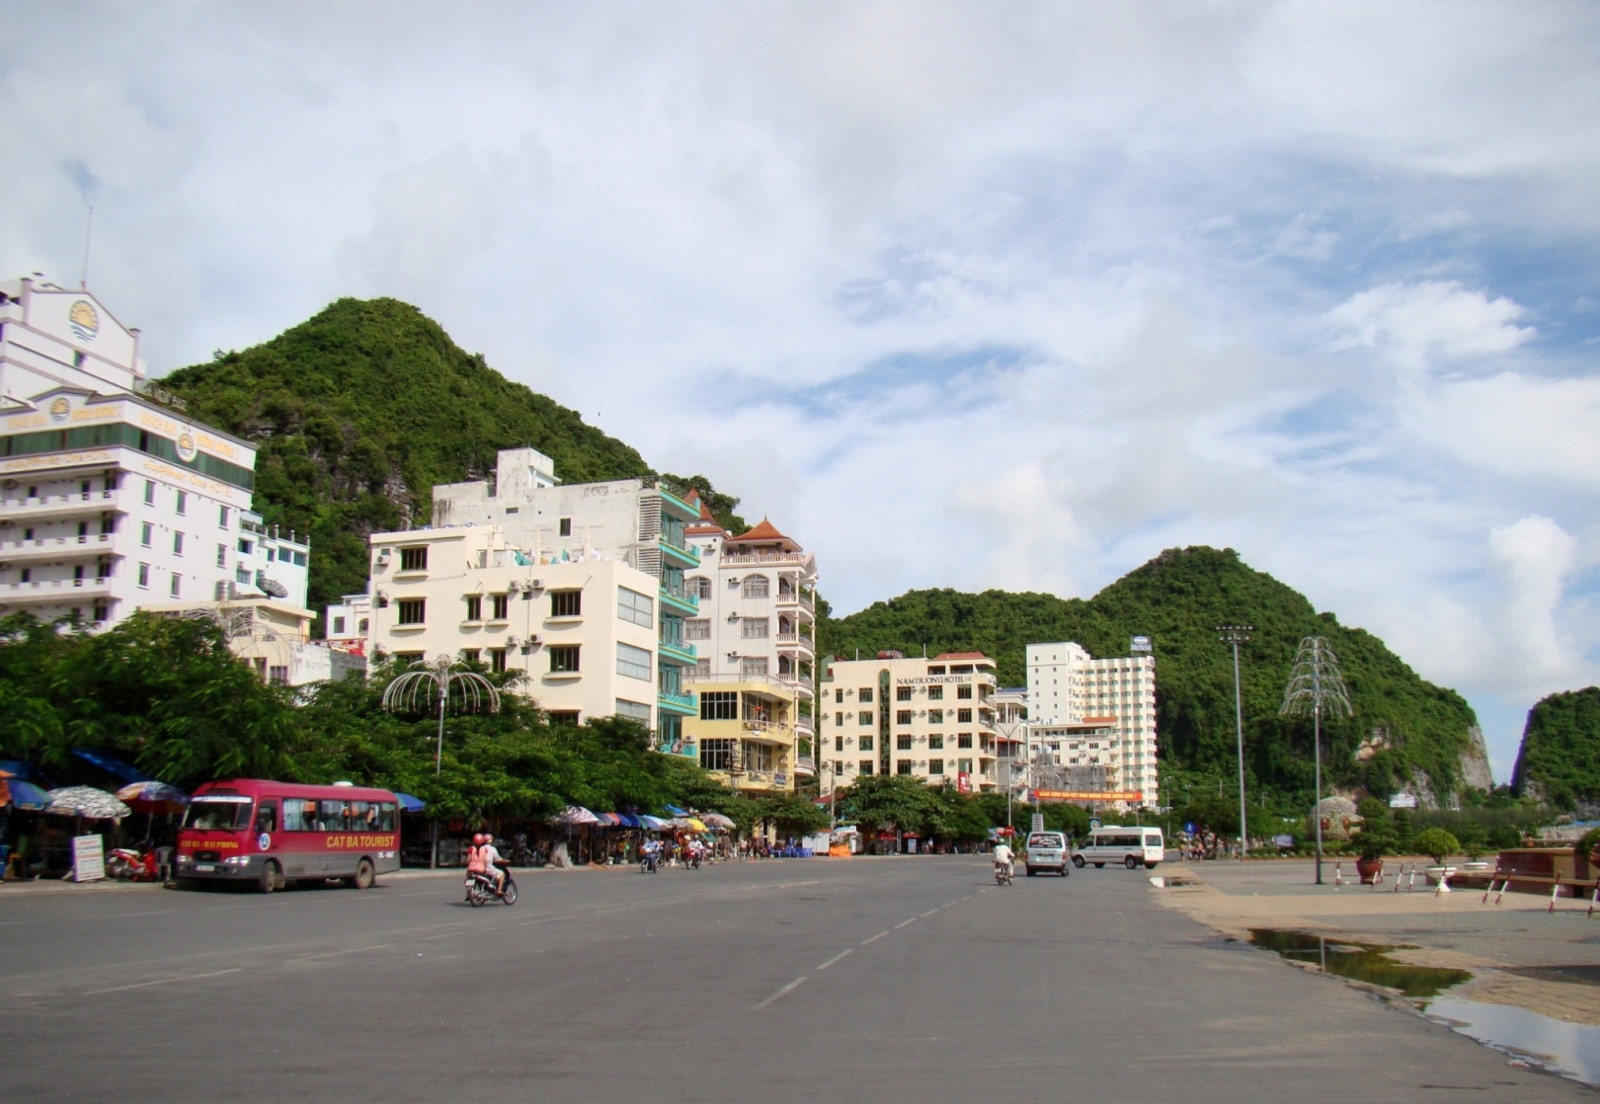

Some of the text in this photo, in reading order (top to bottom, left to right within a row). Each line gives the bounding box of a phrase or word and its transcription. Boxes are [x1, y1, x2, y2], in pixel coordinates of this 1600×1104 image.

[896, 677, 915, 685] NAM
[944, 675, 965, 684] HOTEL
[326, 835, 396, 848] CAT BA TOURIST
